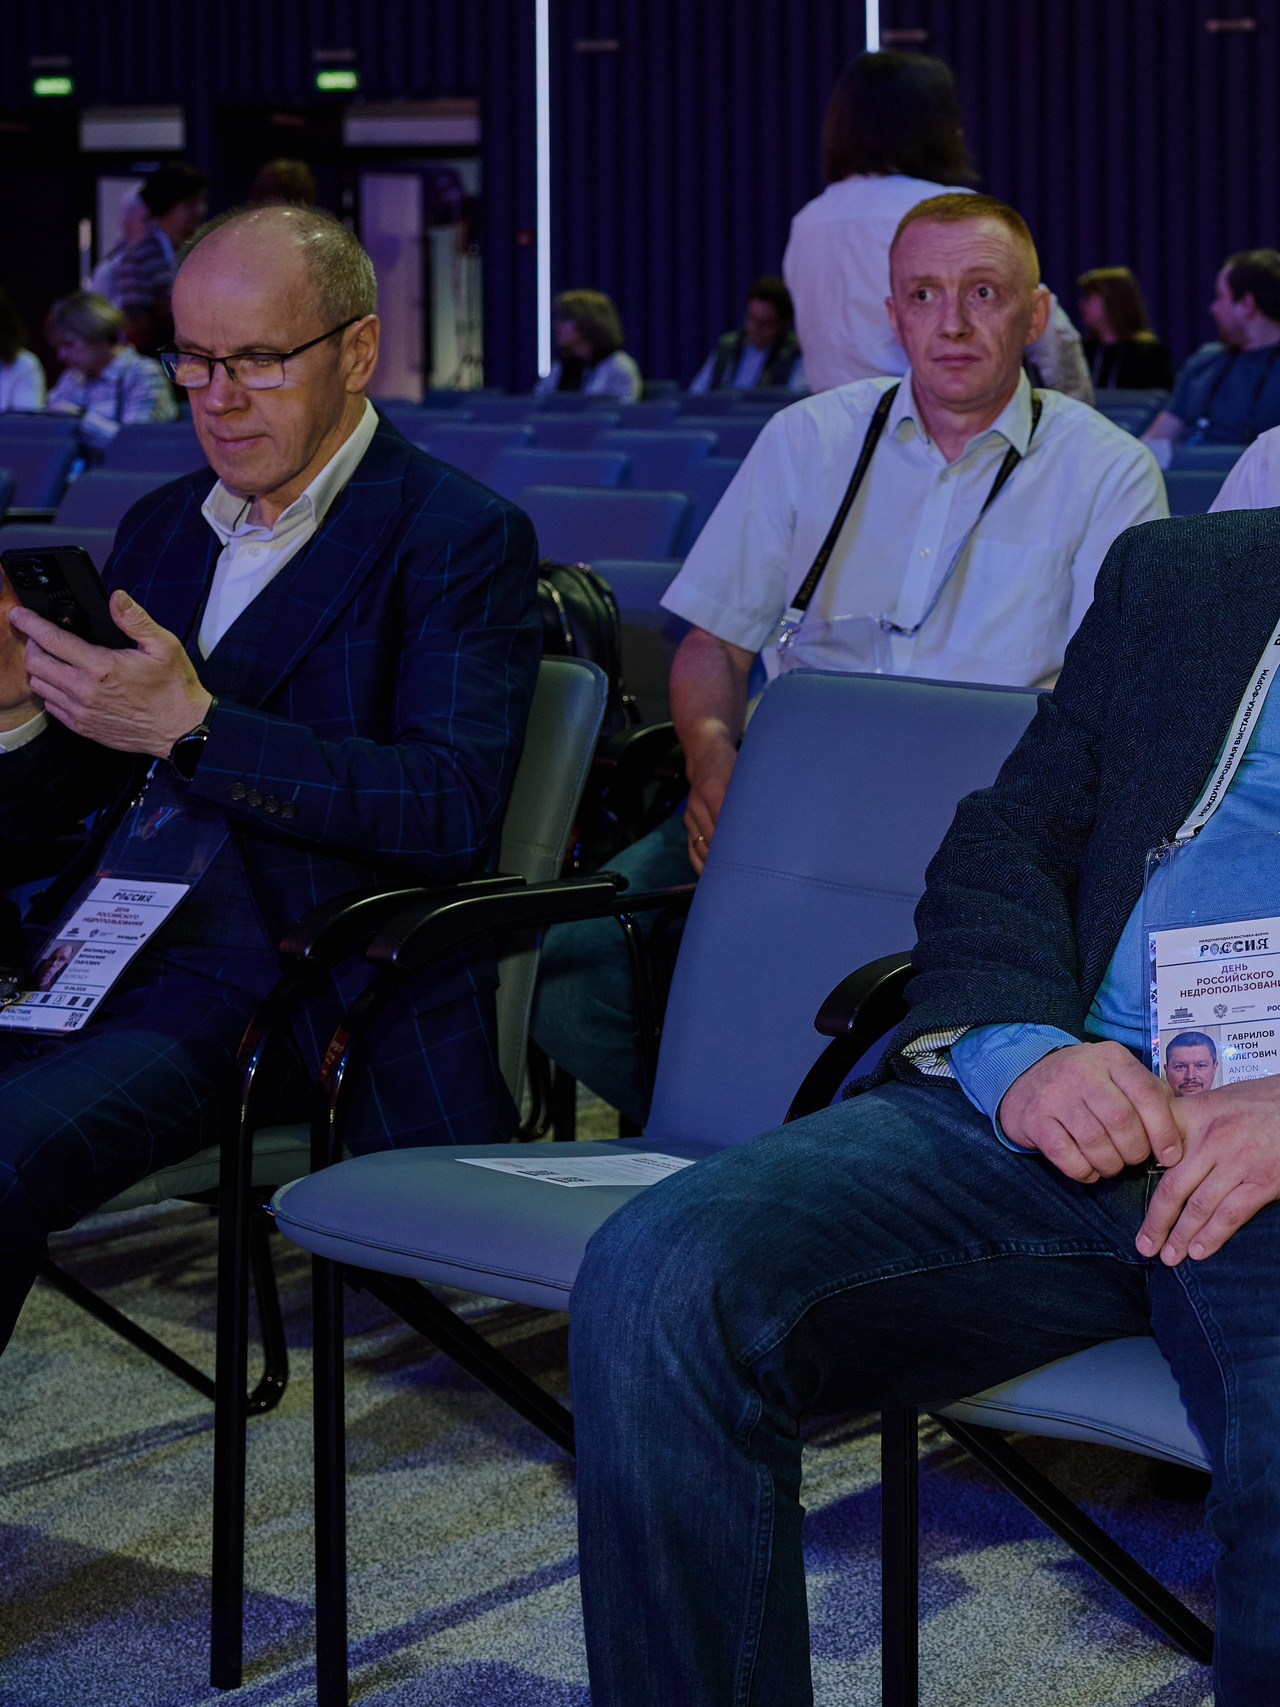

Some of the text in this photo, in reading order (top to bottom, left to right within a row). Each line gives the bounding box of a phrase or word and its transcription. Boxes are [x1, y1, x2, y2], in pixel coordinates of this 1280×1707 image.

[1198, 669, 1270, 817] МЕЖДУНАРОДНАЯ ВЫСТАВКА-ФОРУМ
[1199, 938, 1269, 956] РОССИЯ
[1221, 963, 1248, 974] ДЕНЬ
[1196, 970, 1274, 986] РОССИЙСКОГО
[1227, 1030, 1275, 1041] ГАВРИЛОВ
[1229, 1065, 1259, 1074] ANTON
